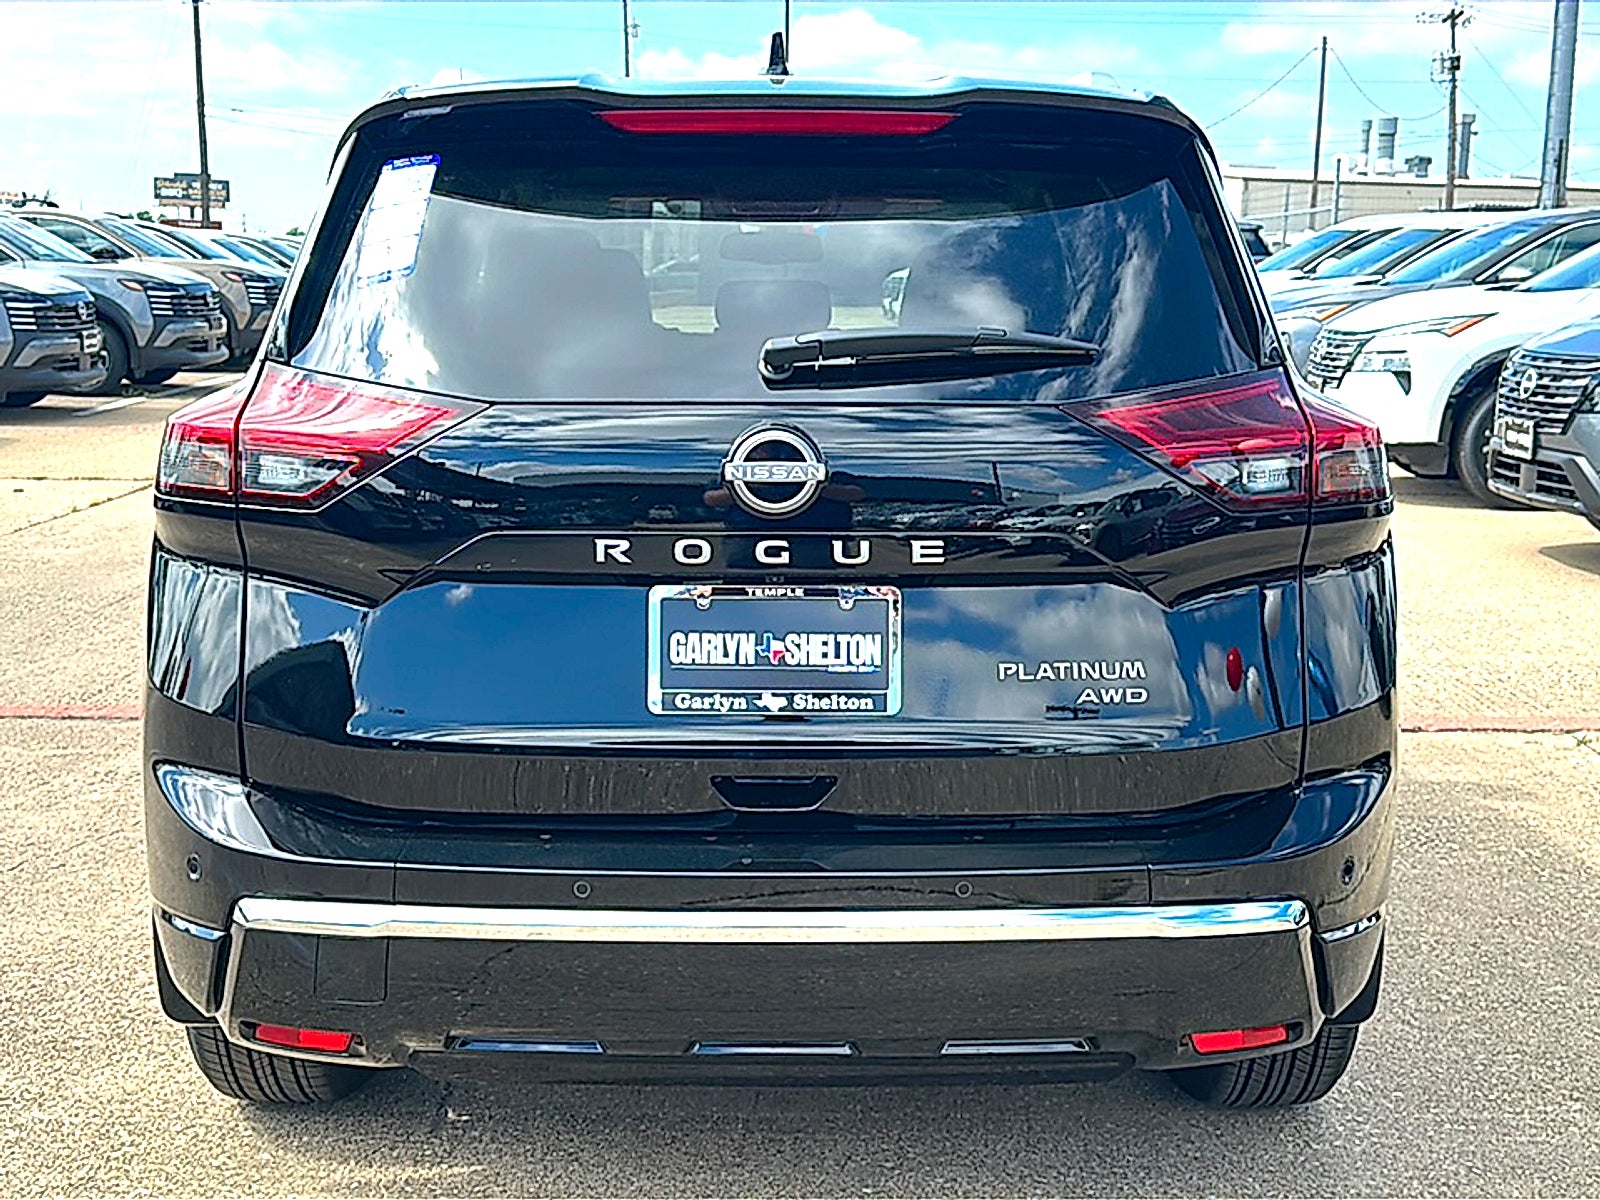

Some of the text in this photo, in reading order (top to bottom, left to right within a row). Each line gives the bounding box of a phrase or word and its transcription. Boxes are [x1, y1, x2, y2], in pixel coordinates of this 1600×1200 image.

[727, 465, 824, 480] NISSAN
[593, 538, 946, 565] ROGUE
[746, 588, 805, 597] TEMPLE
[669, 632, 882, 666] GARLYN SHELTON
[998, 661, 1147, 680] PLATINUM
[674, 693, 874, 713] Garlyn Shelton
[1076, 688, 1148, 704] AWD
